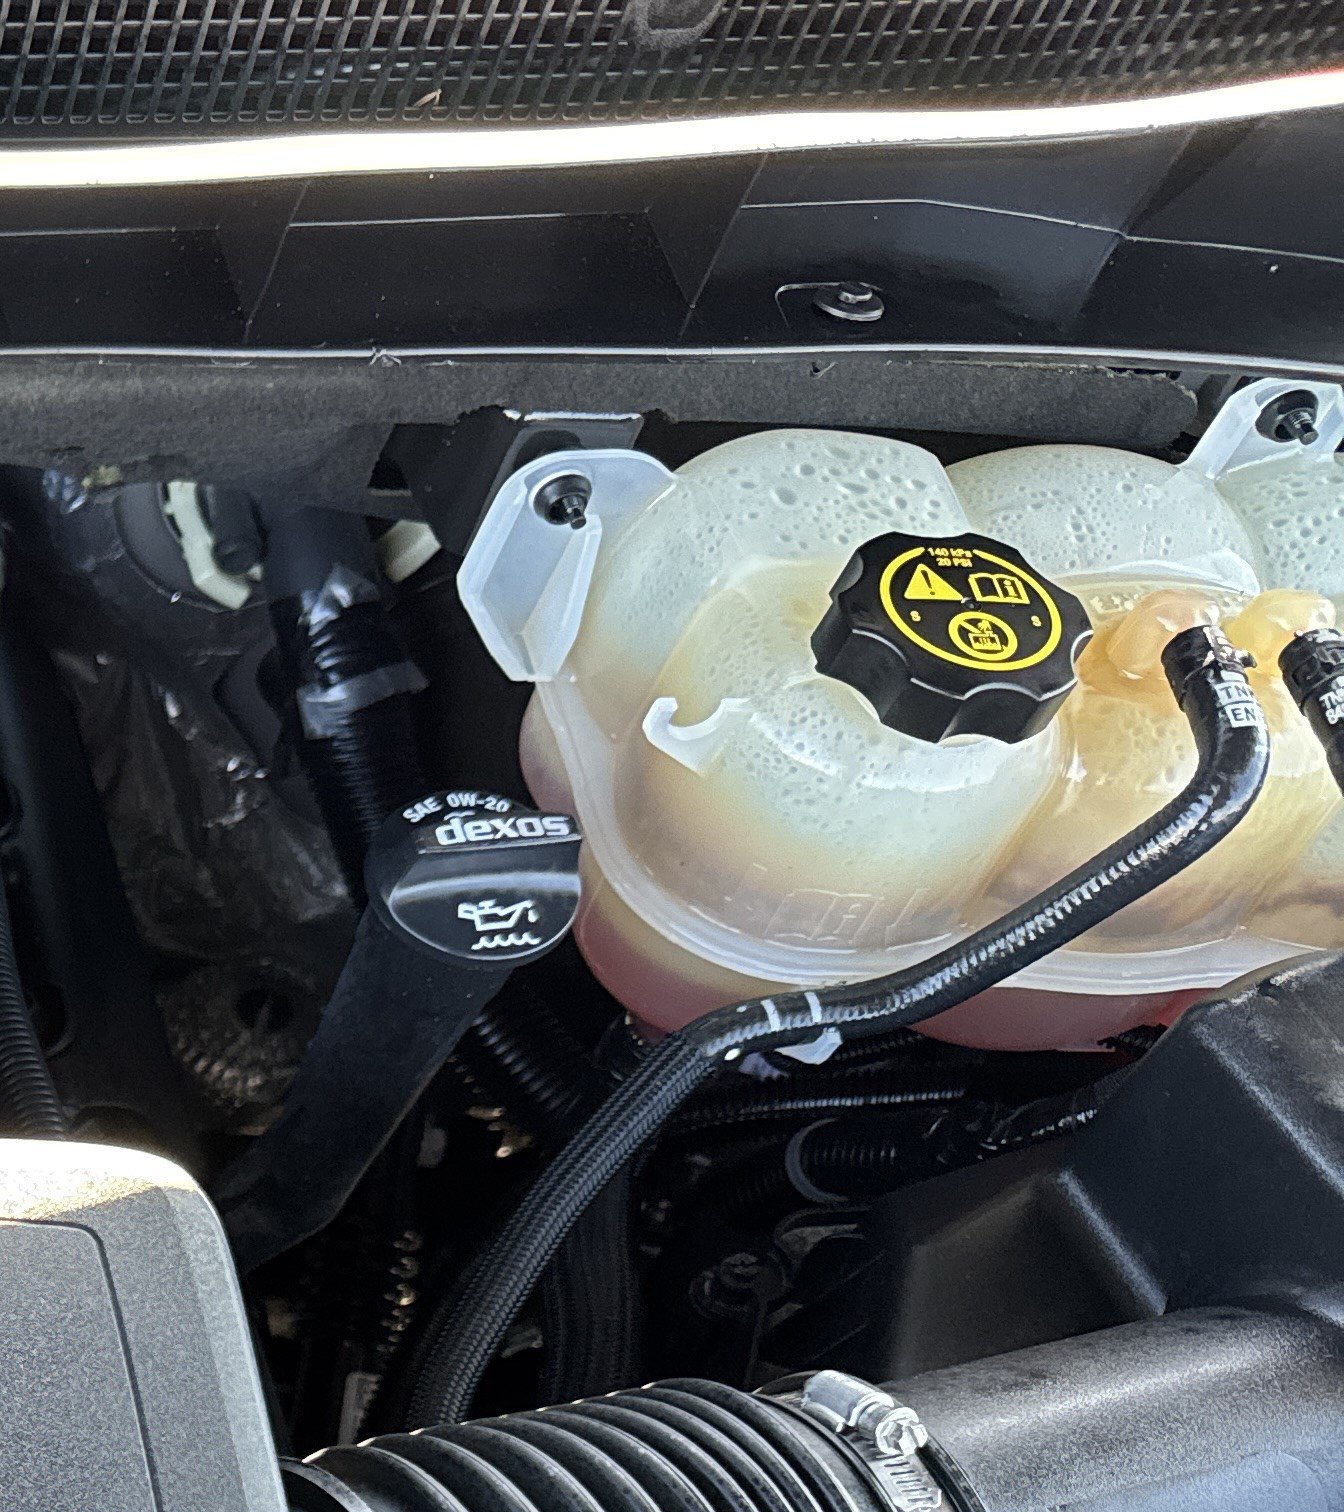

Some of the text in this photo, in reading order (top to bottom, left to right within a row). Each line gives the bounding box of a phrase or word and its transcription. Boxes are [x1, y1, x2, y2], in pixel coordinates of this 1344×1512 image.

[927, 547, 949, 557] 140
[936, 557, 973, 568] 20 PSI
[402, 792, 510, 824] SAE 0W-20
[434, 811, 571, 846] dexos
